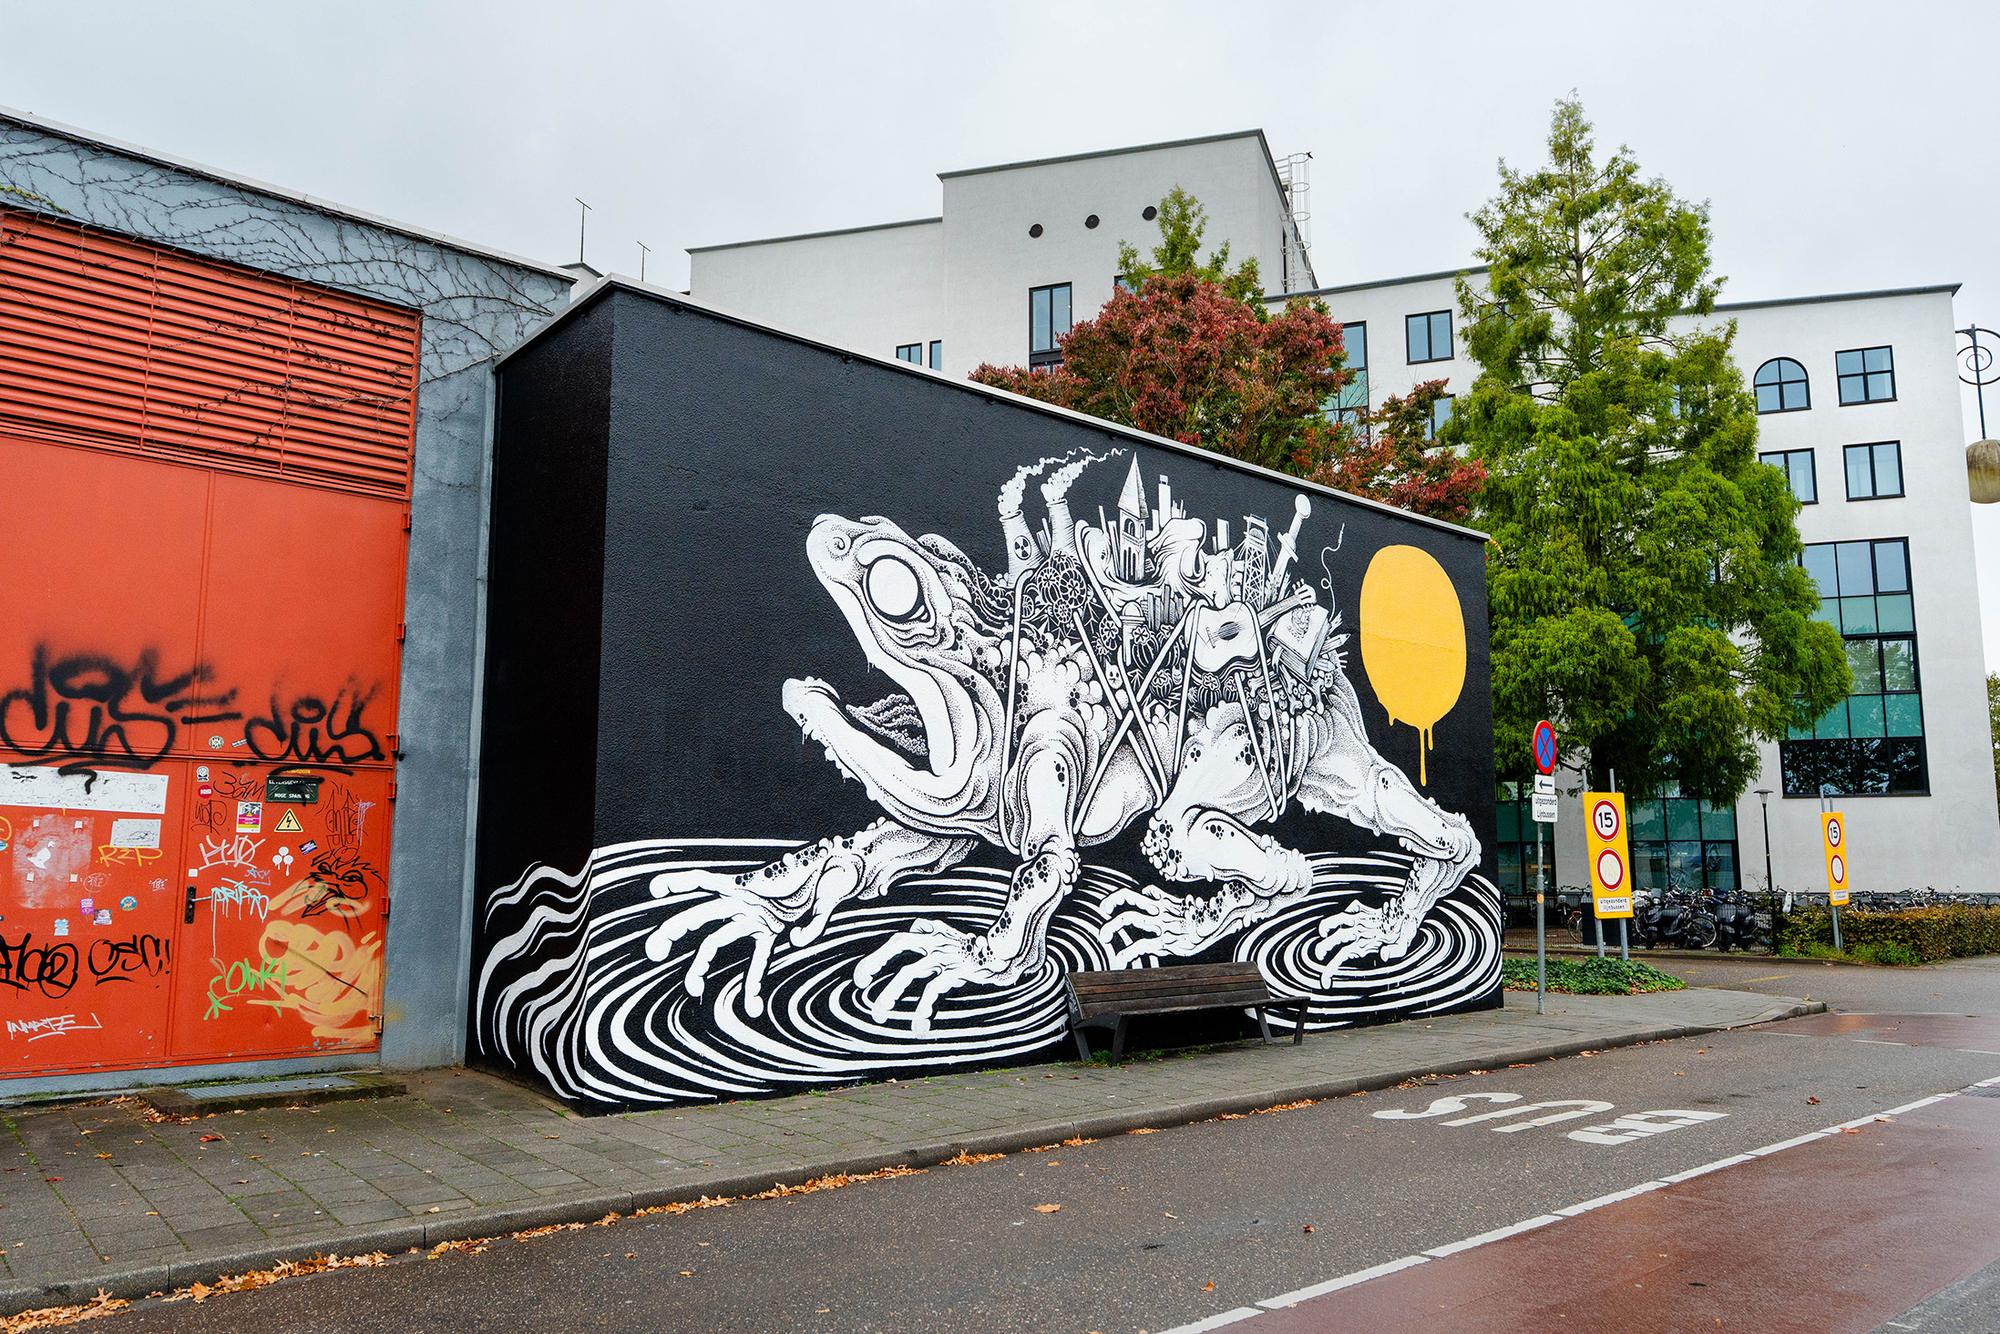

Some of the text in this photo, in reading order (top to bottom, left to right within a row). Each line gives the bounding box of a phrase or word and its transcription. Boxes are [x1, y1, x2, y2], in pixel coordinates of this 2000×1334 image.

[1598, 811, 1614, 828] 15
[1830, 826, 1839, 839] 15
[1372, 1092, 1730, 1145] BUS
